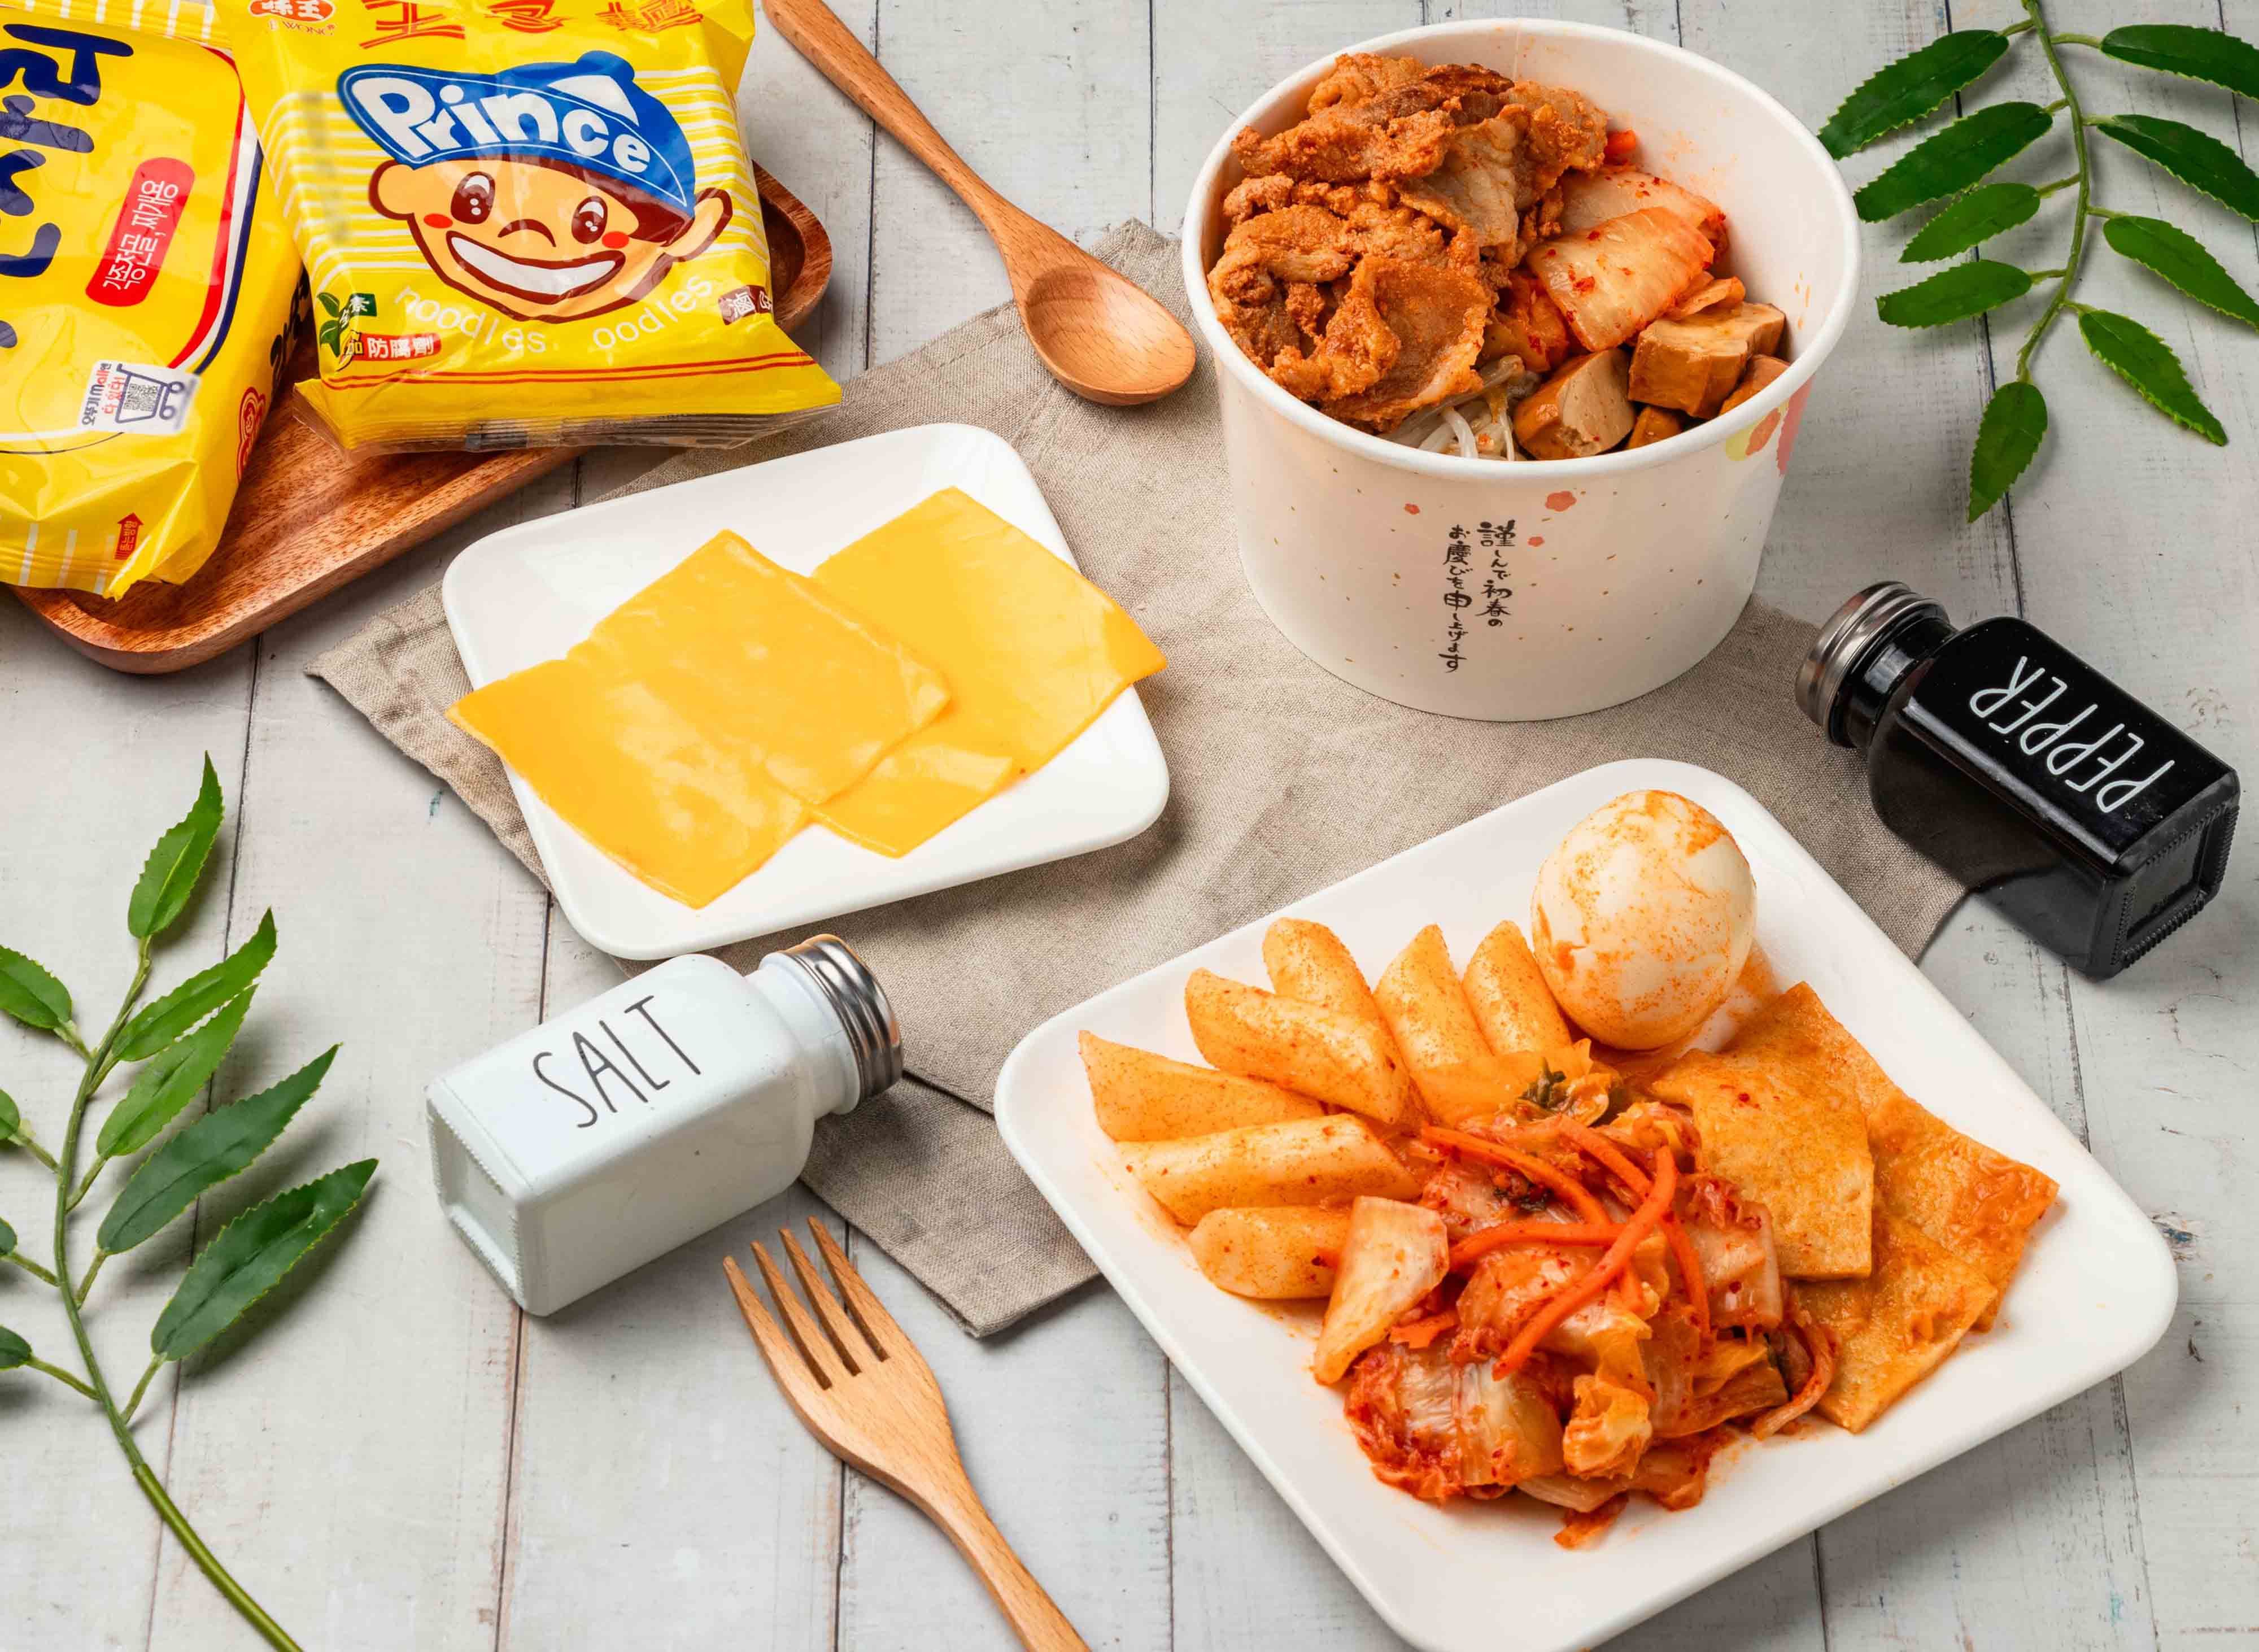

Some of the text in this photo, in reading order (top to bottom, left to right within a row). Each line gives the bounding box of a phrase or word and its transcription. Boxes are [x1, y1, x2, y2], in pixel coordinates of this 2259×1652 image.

[351, 77, 651, 173] Prince
[395, 286, 547, 353] noodles
[1969, 655, 2175, 813] PEPPER
[533, 995, 701, 1128] SALT
